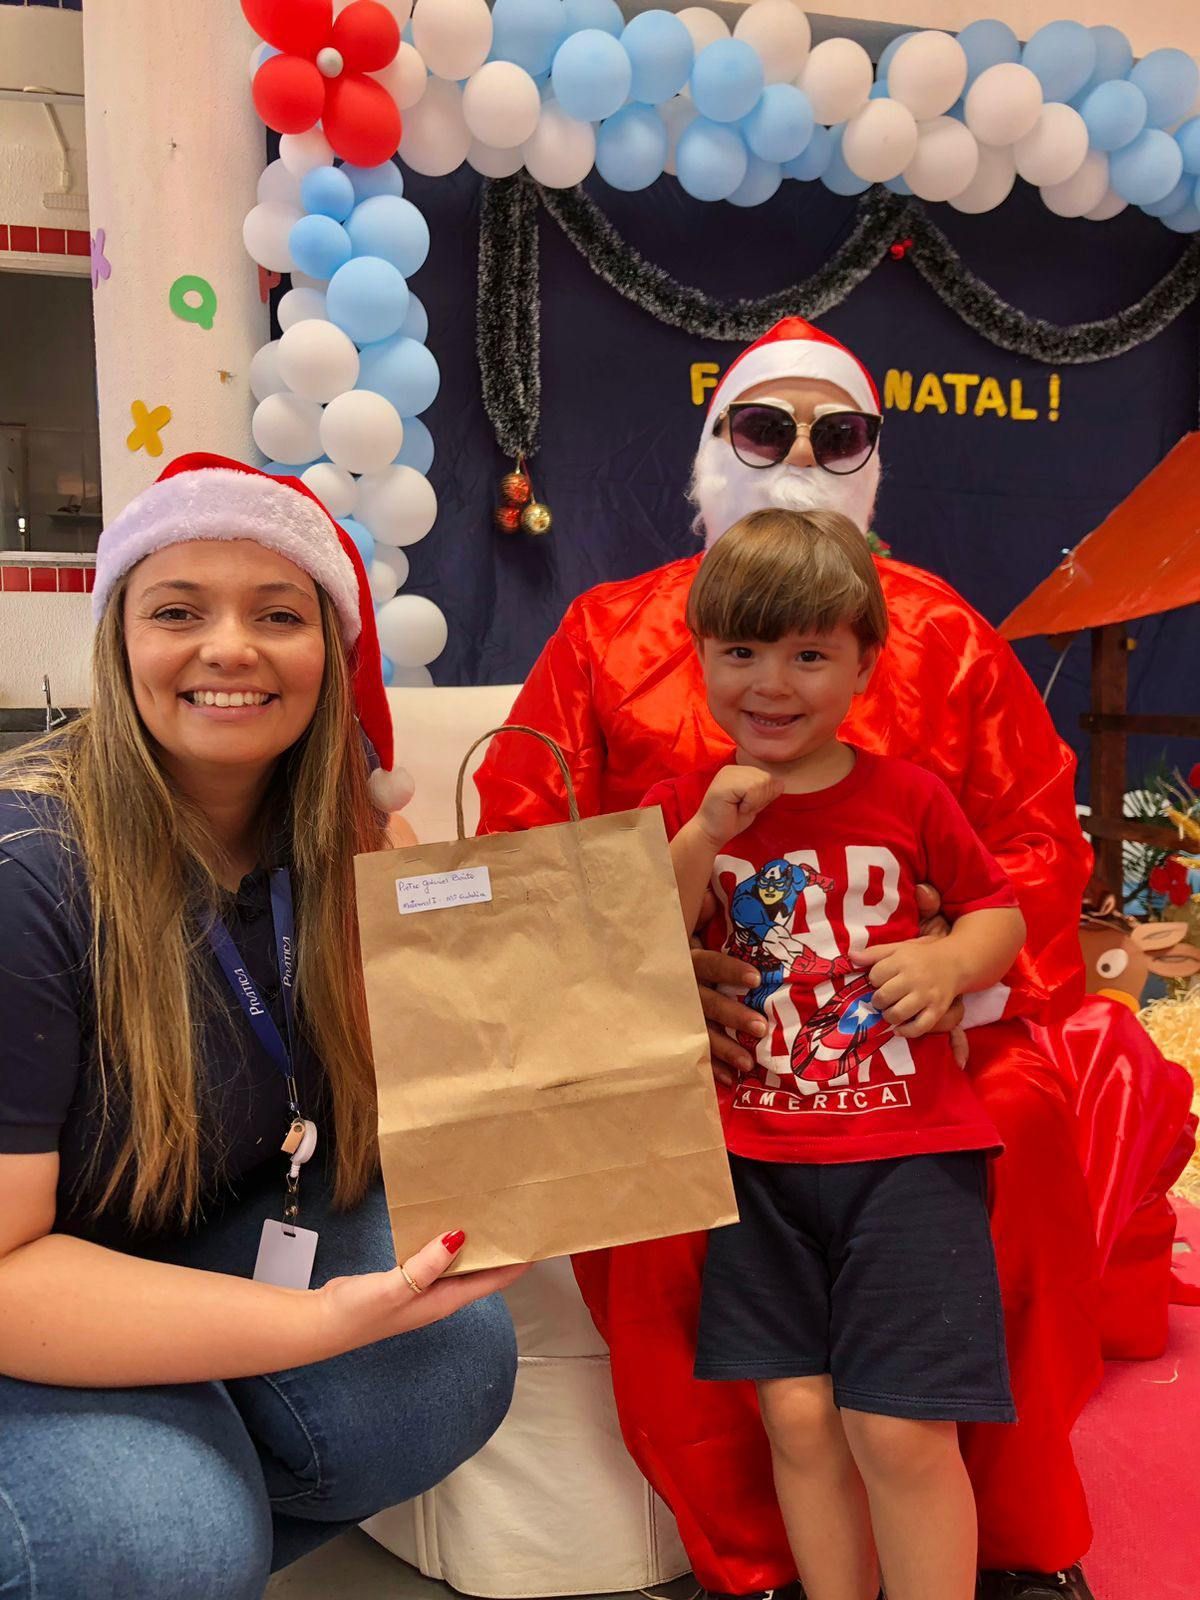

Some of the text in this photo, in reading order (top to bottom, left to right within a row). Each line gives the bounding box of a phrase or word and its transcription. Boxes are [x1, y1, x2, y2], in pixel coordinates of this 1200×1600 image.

[169, 274, 217, 331] Q
[690, 362, 720, 405] F
[126, 399, 172, 458] X
[741, 1086, 897, 1111] AMERICA
